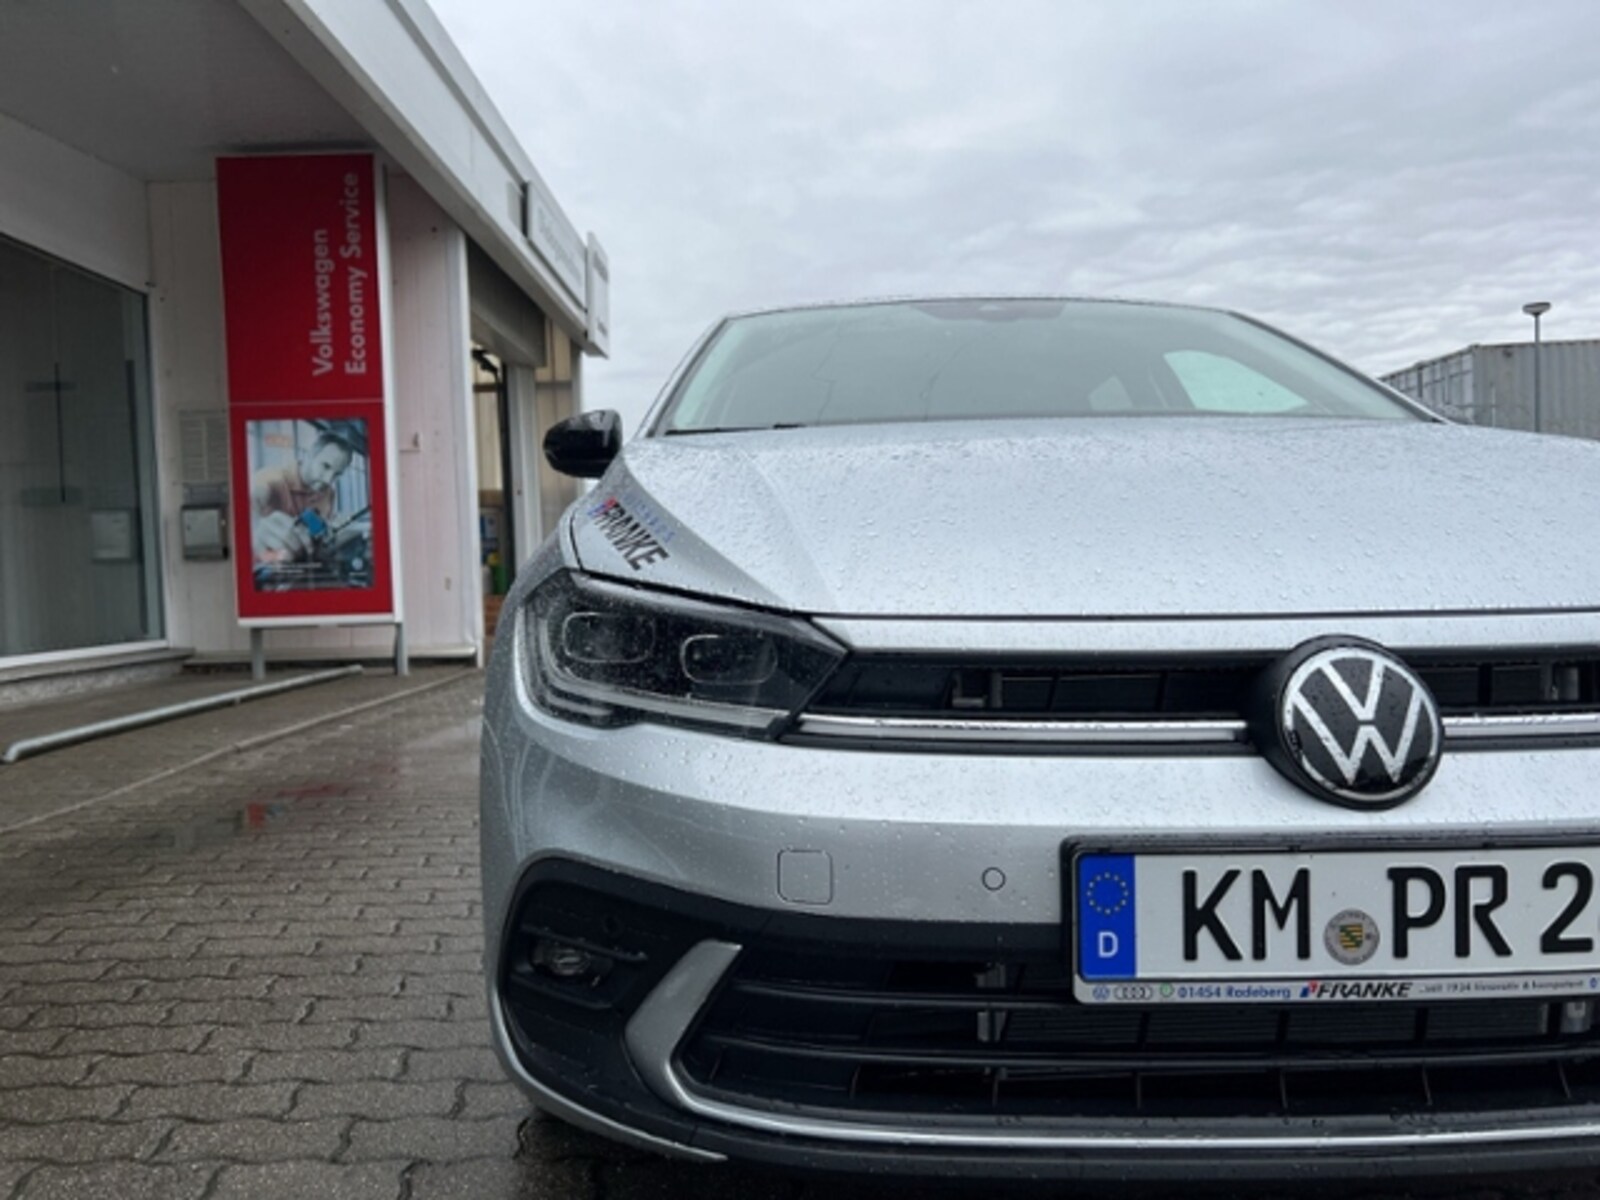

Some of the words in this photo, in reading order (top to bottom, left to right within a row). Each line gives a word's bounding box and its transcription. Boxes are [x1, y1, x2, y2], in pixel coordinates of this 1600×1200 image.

[339, 172, 362, 259] Service
[309, 228, 335, 376] Volkswagen
[345, 266, 368, 375] Economy
[594, 501, 670, 571] FRANKE
[1098, 931, 1118, 958] D
[1182, 867, 1311, 962] KM
[1386, 864, 1513, 960] PR
[1540, 861, 1600, 955] 2
[1316, 981, 1413, 999] FRANKE
